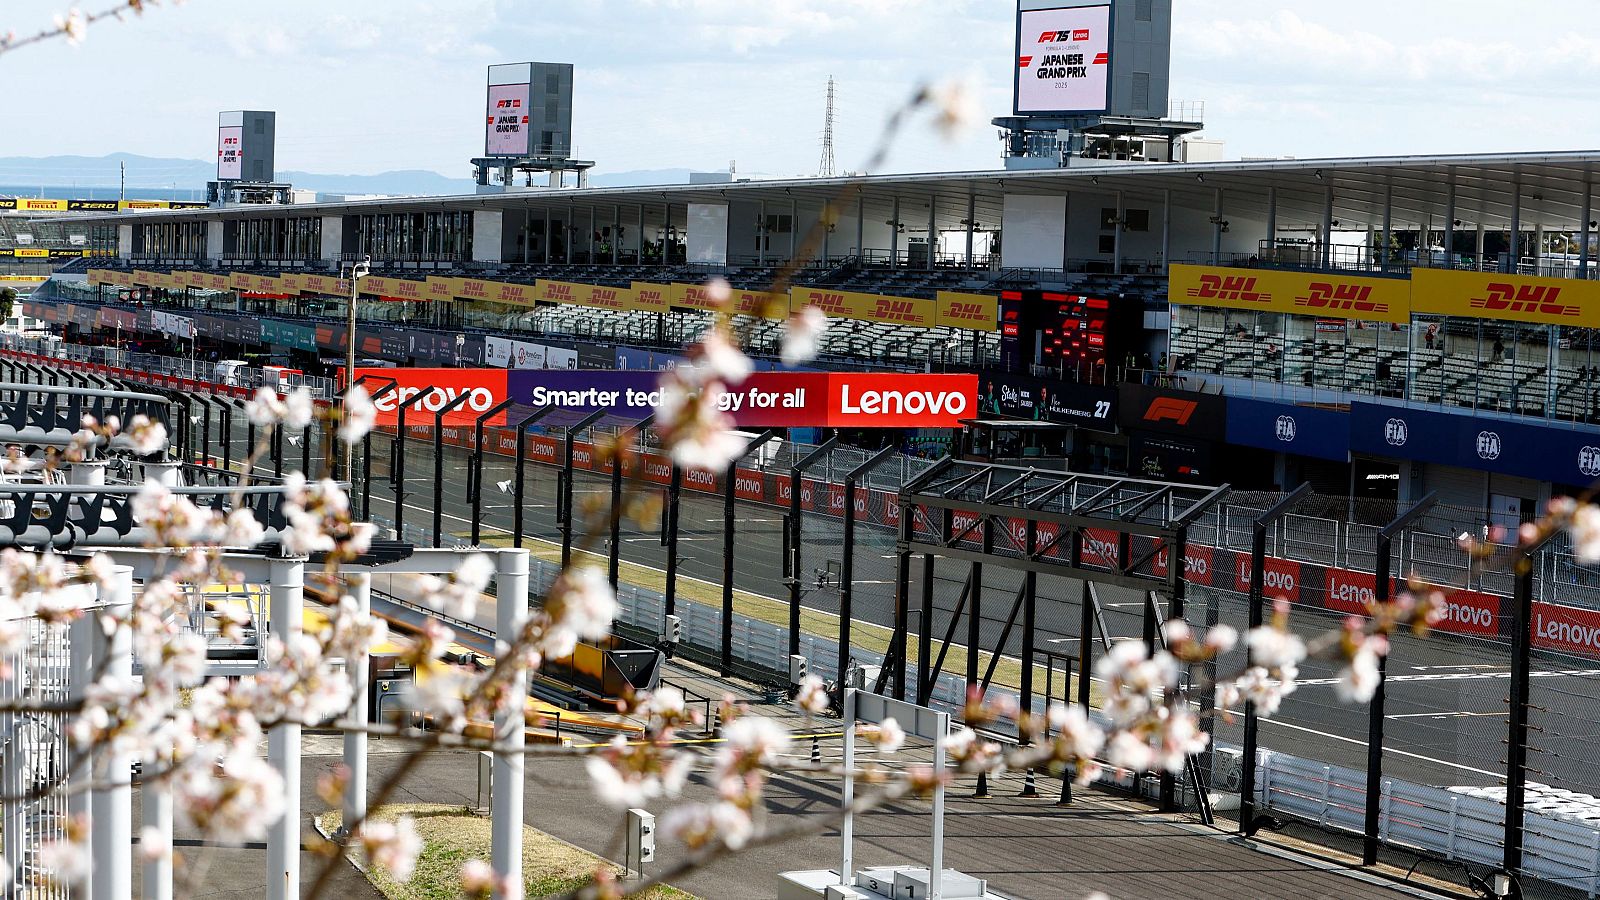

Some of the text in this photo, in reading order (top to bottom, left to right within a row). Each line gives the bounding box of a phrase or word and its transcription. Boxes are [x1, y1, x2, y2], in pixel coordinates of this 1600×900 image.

[1041, 54, 1083, 66] JAPANESE
[1037, 66, 1087, 79] GRAND PRIX
[546, 283, 571, 299] DHL
[1198, 274, 1262, 302] DHL
[1306, 282, 1379, 312] DHL
[591, 288, 618, 307] DHL
[639, 291, 661, 304] DHL
[1484, 283, 1566, 315] DHL
[875, 300, 917, 321] DHL
[949, 302, 983, 320] DHL
[374, 385, 493, 412] enovo
[533, 387, 619, 407] Smarter
[749, 388, 780, 407] for
[783, 388, 805, 407] all
[842, 385, 966, 414] Lenovo
[1094, 400, 1111, 418] 27
[533, 441, 553, 456] Lenovo
[645, 459, 670, 477] Lenovo
[686, 467, 714, 485] Lenovo
[735, 477, 760, 494] enovo
[1330, 577, 1377, 607] Lenov
[1437, 602, 1493, 628] enovo
[869, 880, 878, 890] 3
[905, 885, 914, 898] 1
